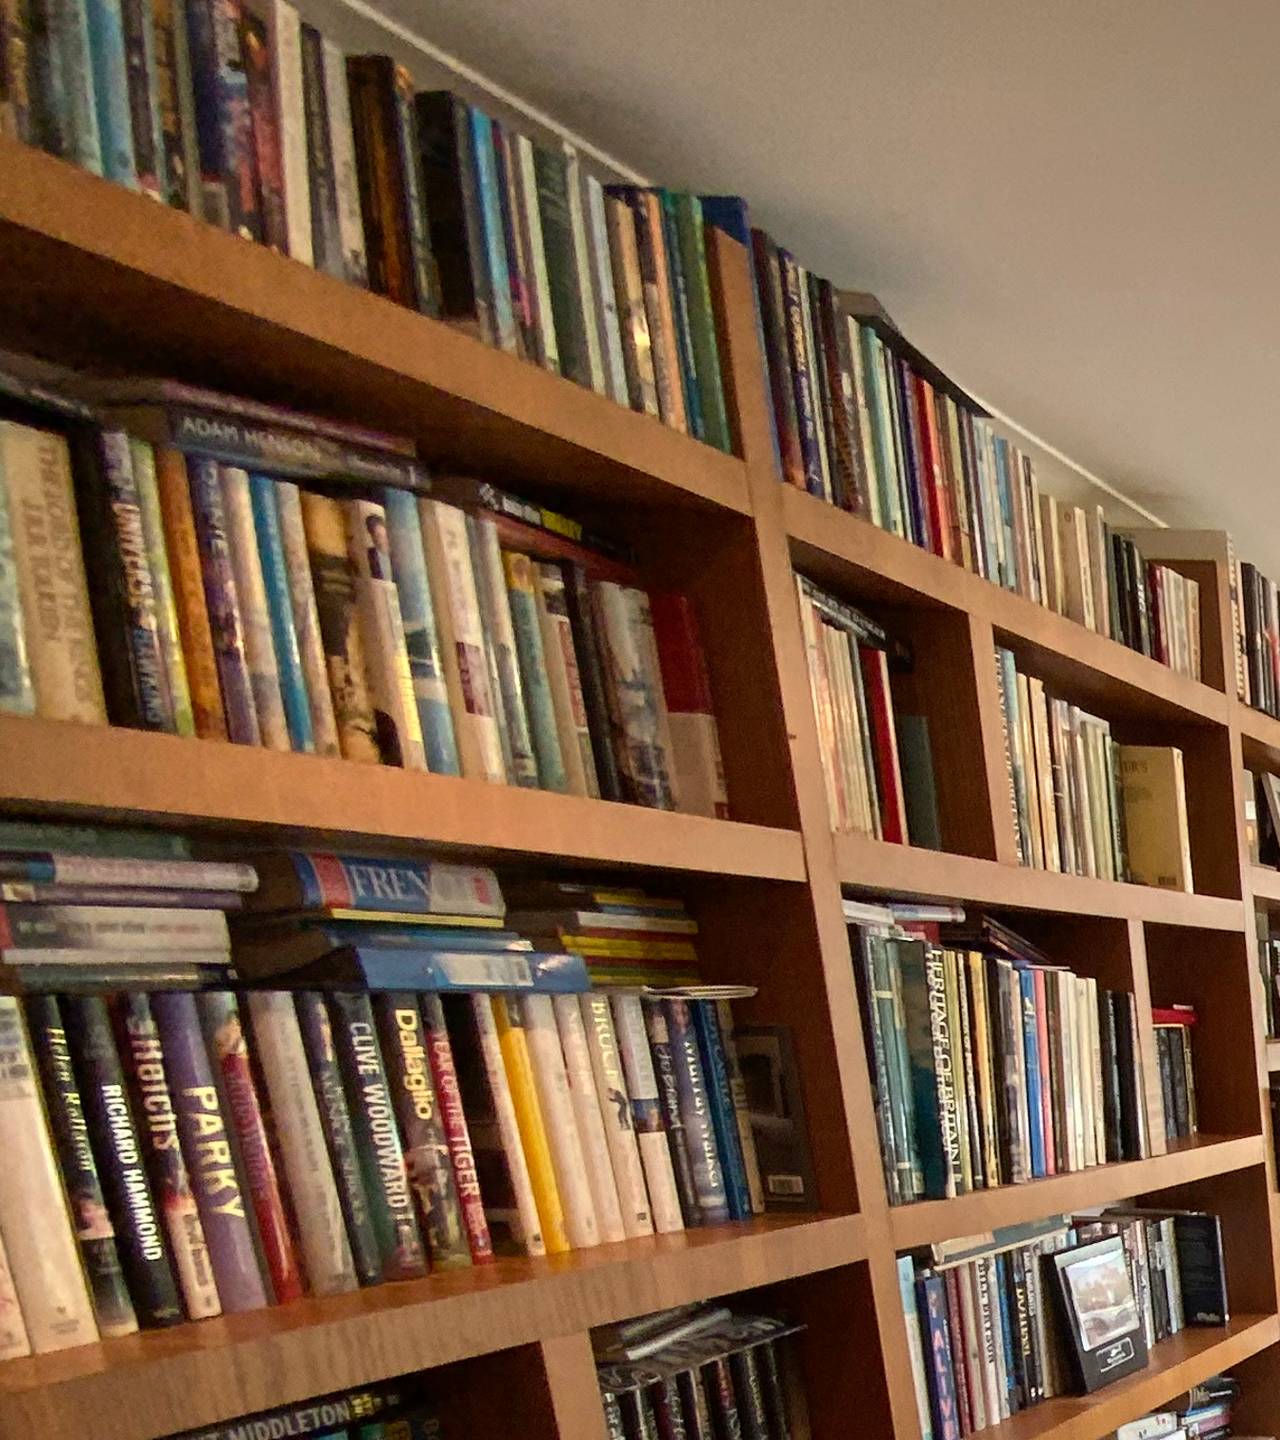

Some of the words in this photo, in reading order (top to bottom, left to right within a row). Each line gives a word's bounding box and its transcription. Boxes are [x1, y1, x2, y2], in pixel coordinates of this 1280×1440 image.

[350, 1022, 380, 1075] CLIVE
[395, 1008, 433, 1120] Dallaglio
[102, 1084, 138, 1164] RICHARD
[122, 1168, 162, 1261] HAMMOND
[181, 1086, 245, 1218] PARKY
[363, 1083, 408, 1209] WOODWARD
[451, 1130, 480, 1198] TIGER
